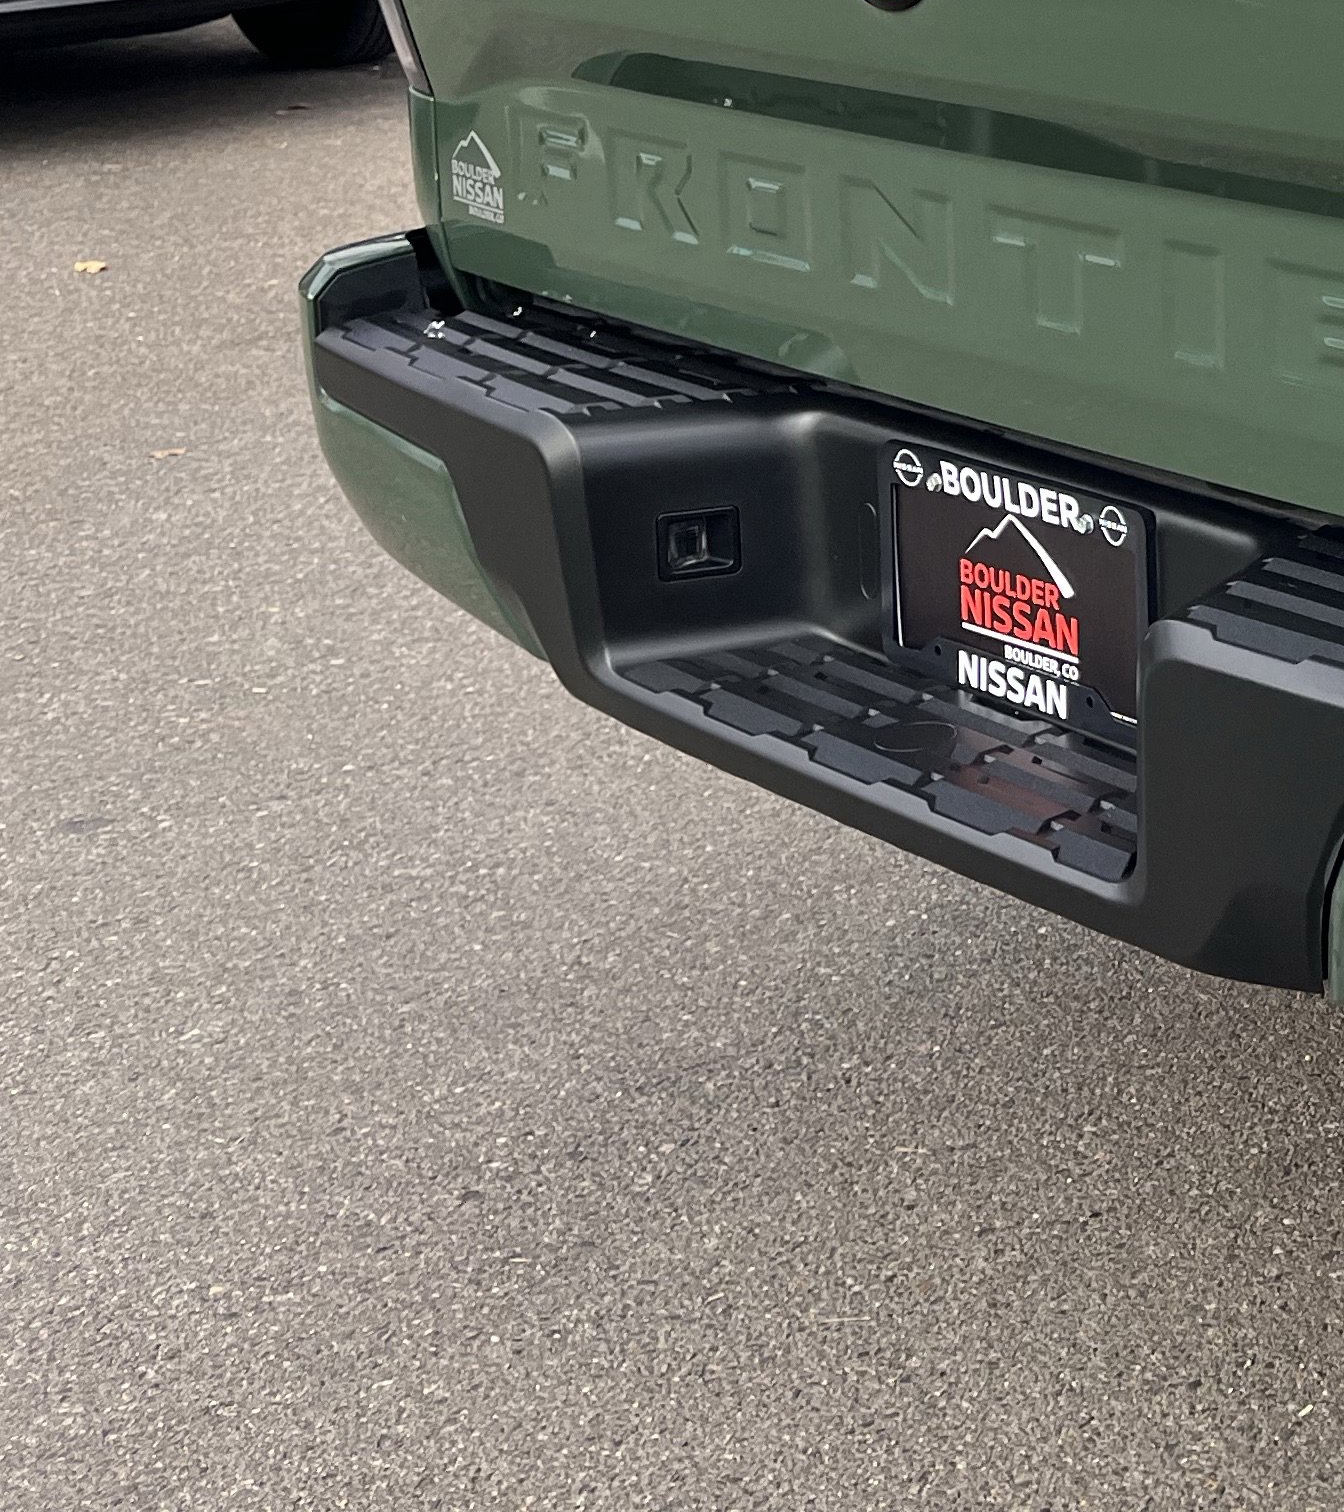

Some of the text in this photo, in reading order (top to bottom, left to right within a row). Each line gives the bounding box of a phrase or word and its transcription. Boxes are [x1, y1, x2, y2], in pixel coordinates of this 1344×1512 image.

[451, 159, 496, 185] BOULDER
[452, 174, 505, 210] NISSAN
[939, 459, 1086, 535] BOULDER
[959, 557, 1060, 610] BOULDER
[960, 584, 1079, 657] NISSAN
[957, 649, 1068, 720] NISSAN
[1061, 662, 1079, 681] CO
